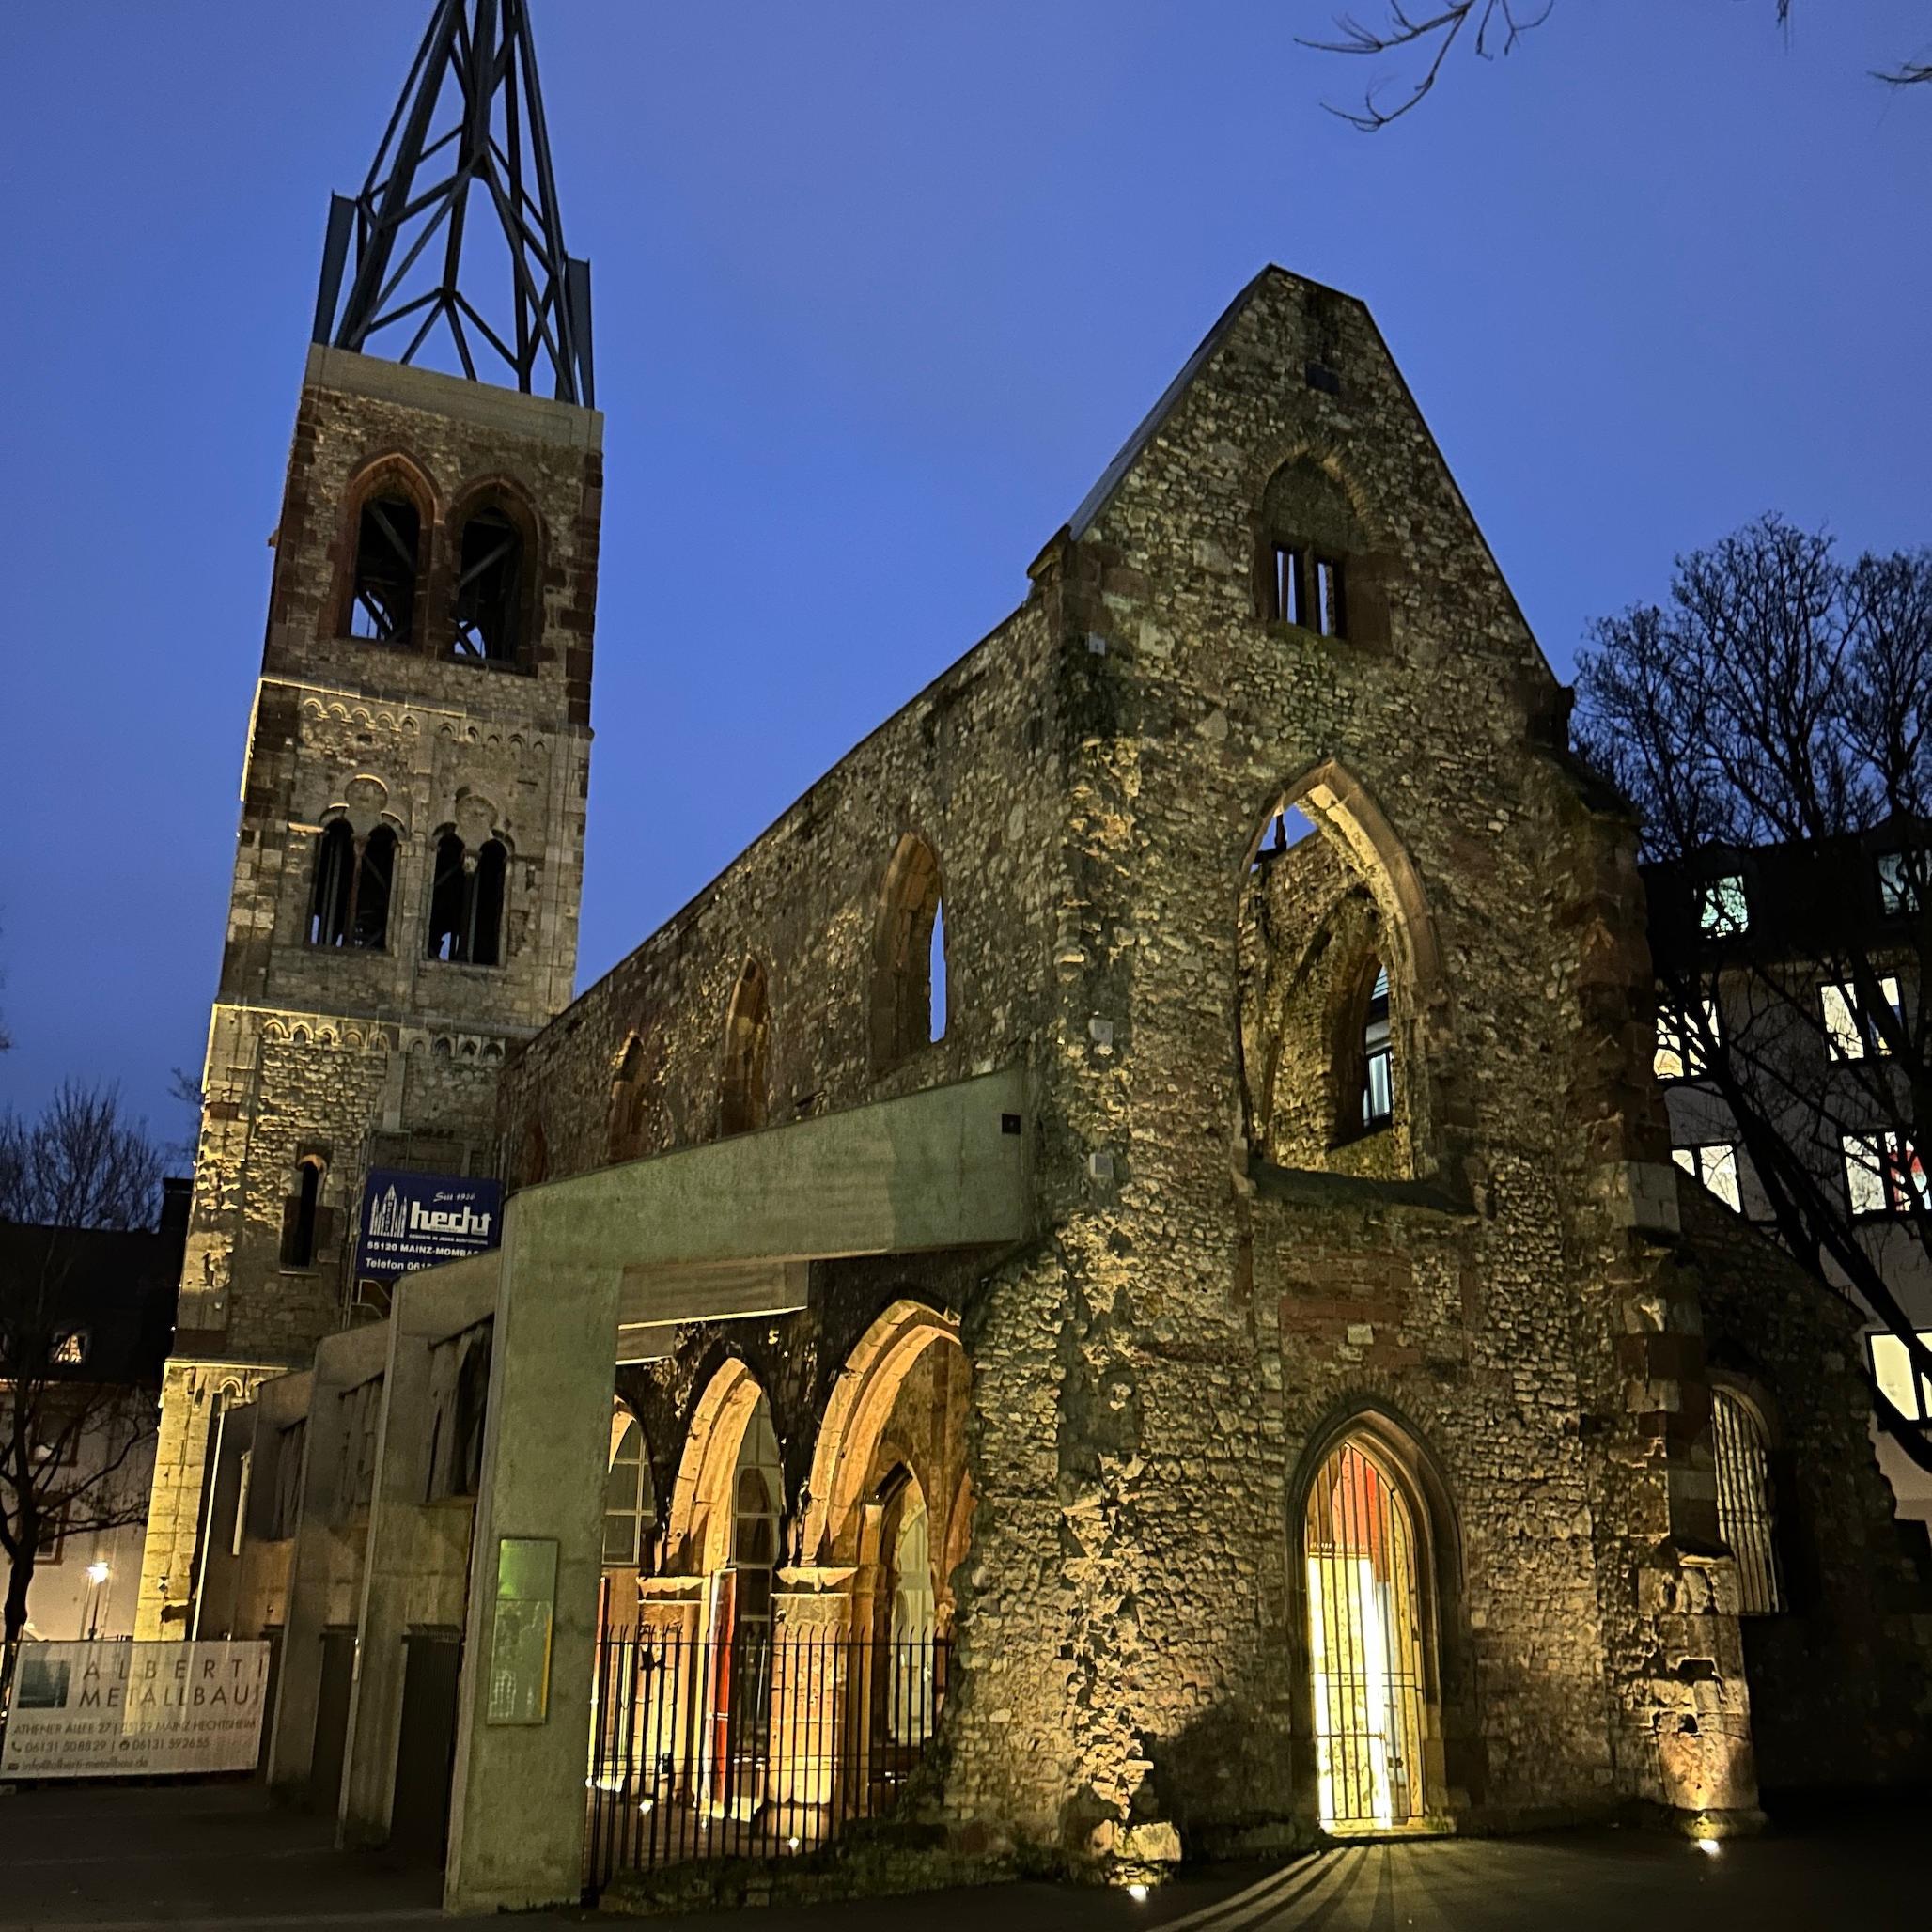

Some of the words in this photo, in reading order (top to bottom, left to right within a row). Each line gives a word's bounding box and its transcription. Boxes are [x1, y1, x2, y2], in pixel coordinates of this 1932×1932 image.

[433, 1192, 454, 1202] Seit
[410, 1200, 492, 1237] hecht
[366, 1257, 404, 1270] Telefon
[83, 1659, 263, 1680] ALBERTI
